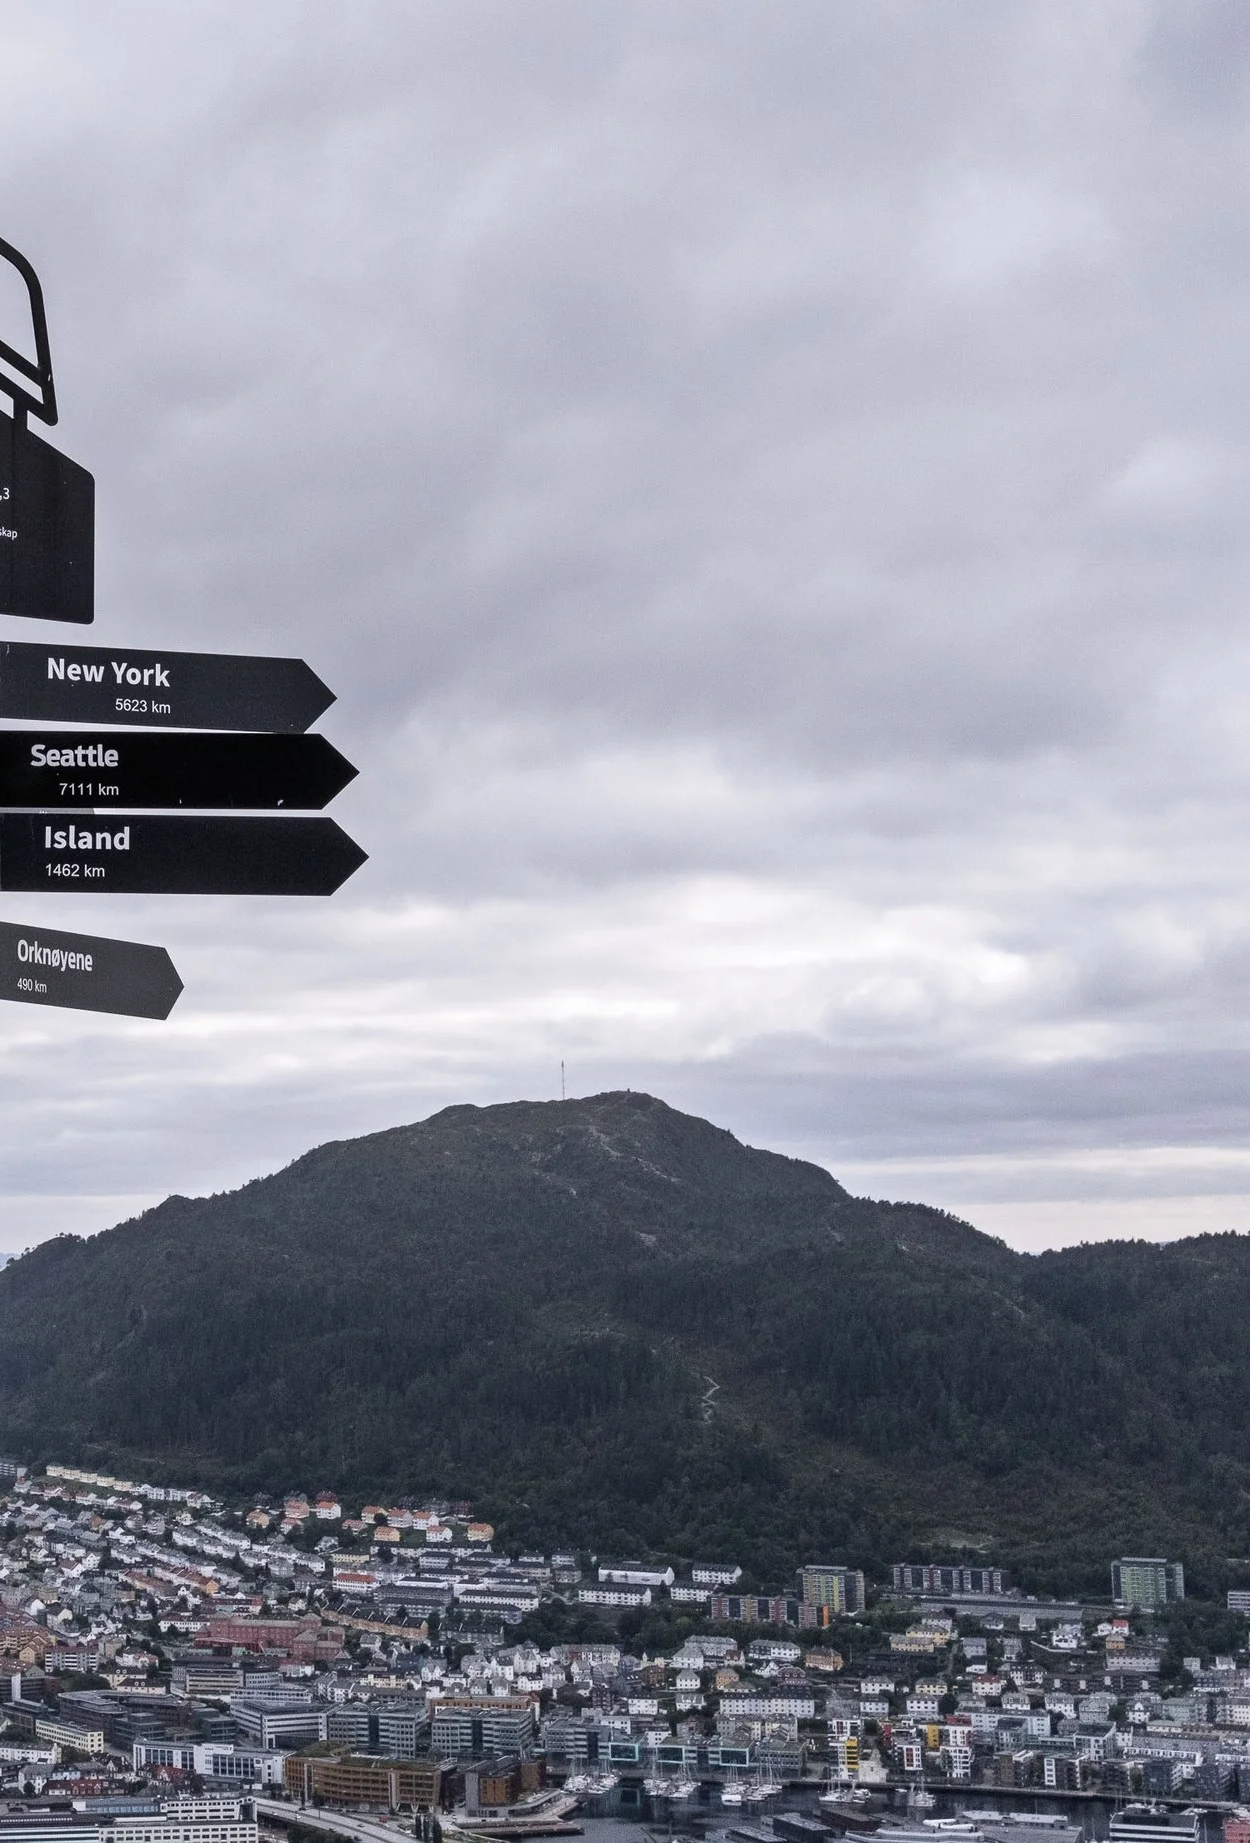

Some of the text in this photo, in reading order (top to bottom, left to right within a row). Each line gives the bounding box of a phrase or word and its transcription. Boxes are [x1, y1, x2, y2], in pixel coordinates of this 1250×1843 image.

[47, 658, 170, 687] New York
[116, 699, 170, 713] 5623 km
[31, 744, 118, 766] Seattle
[60, 783, 118, 795] 7111 km
[45, 825, 129, 850] Island
[46, 864, 105, 877] 1462 km
[18, 940, 92, 971] Orknøyene
[16, 978, 47, 993] 490 km
